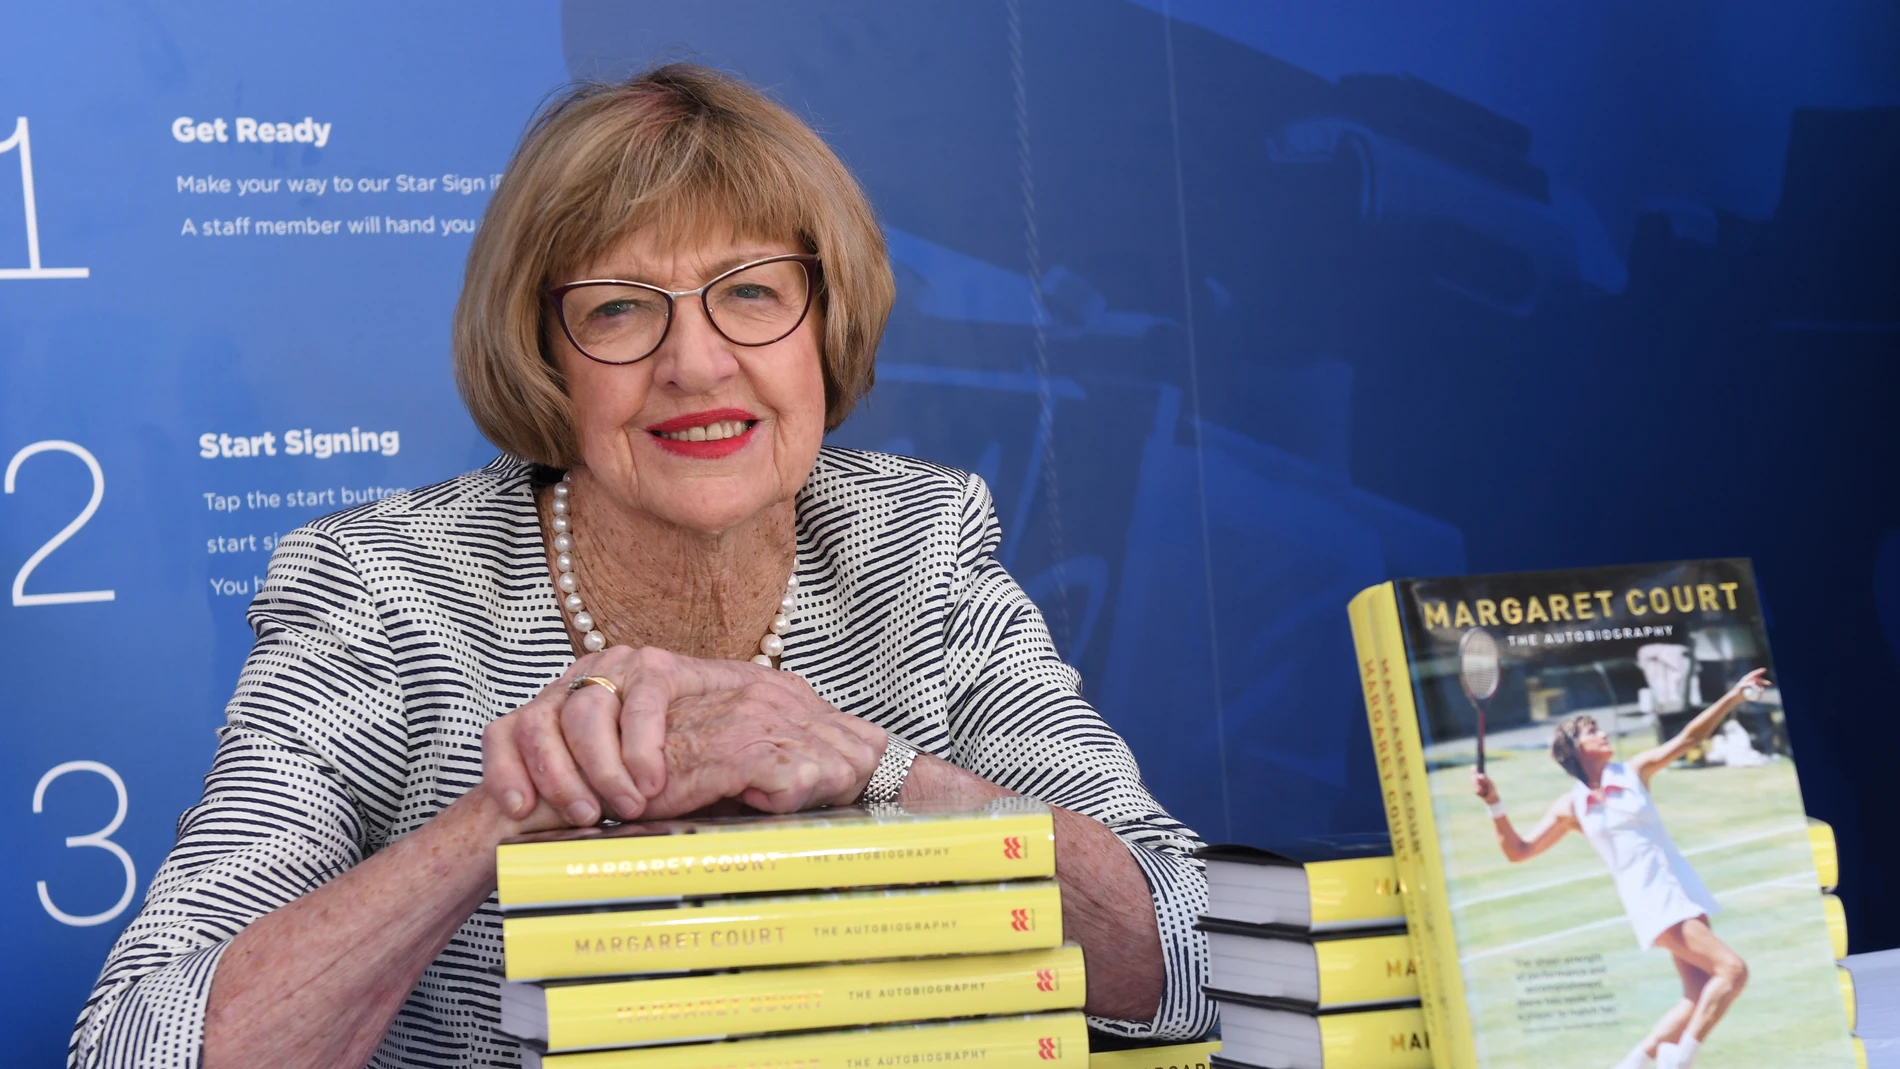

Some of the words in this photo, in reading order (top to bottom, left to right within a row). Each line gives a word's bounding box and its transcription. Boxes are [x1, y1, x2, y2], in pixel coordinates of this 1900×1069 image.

[171, 117, 228, 144] Get
[236, 116, 332, 148] Ready
[0, 116, 90, 279] 1
[176, 175, 232, 194] Make
[236, 177, 281, 197] your
[287, 177, 328, 197] way
[333, 175, 354, 193] to
[357, 177, 390, 193] our
[395, 174, 437, 193] Star
[442, 173, 486, 196] Sign
[181, 218, 198, 236] A
[202, 216, 251, 236] staff
[255, 217, 342, 236] member
[347, 216, 382, 234] will
[386, 216, 436, 234] hand
[440, 218, 476, 238] you
[199, 430, 277, 459] Start
[283, 426, 401, 459] Signing
[203, 492, 241, 513] Tap
[247, 490, 281, 509] the
[286, 488, 336, 508] start
[4, 439, 116, 607] 2
[207, 533, 257, 554] start
[209, 577, 249, 596] You
[1423, 589, 1614, 630] MARGARET
[1625, 581, 1740, 616] COURT
[1507, 634, 1539, 647] THE
[1544, 625, 1674, 645] AUTOBIOGRAPHY
[1364, 658, 1394, 782] MARGARET
[1387, 790, 1409, 863] COURT
[32, 760, 136, 927] 3
[566, 856, 696, 880] MARGARET
[701, 851, 781, 874] COURT
[805, 854, 831, 864] THE
[837, 847, 951, 862] AUTOBIOGRAPHY
[574, 931, 702, 955] MARGARET
[710, 926, 787, 949] COURT
[813, 926, 839, 937] THE
[844, 920, 958, 935] AUTOBIOGRAPHY
[616, 997, 741, 1023] MARGARET
[750, 989, 824, 1013] COURT
[848, 990, 872, 1001] THE
[878, 982, 987, 998] AUTOBIOGRAPHY
[846, 1058, 872, 1069] THE
[877, 1050, 988, 1067] AUTOBIOGRAPHY
